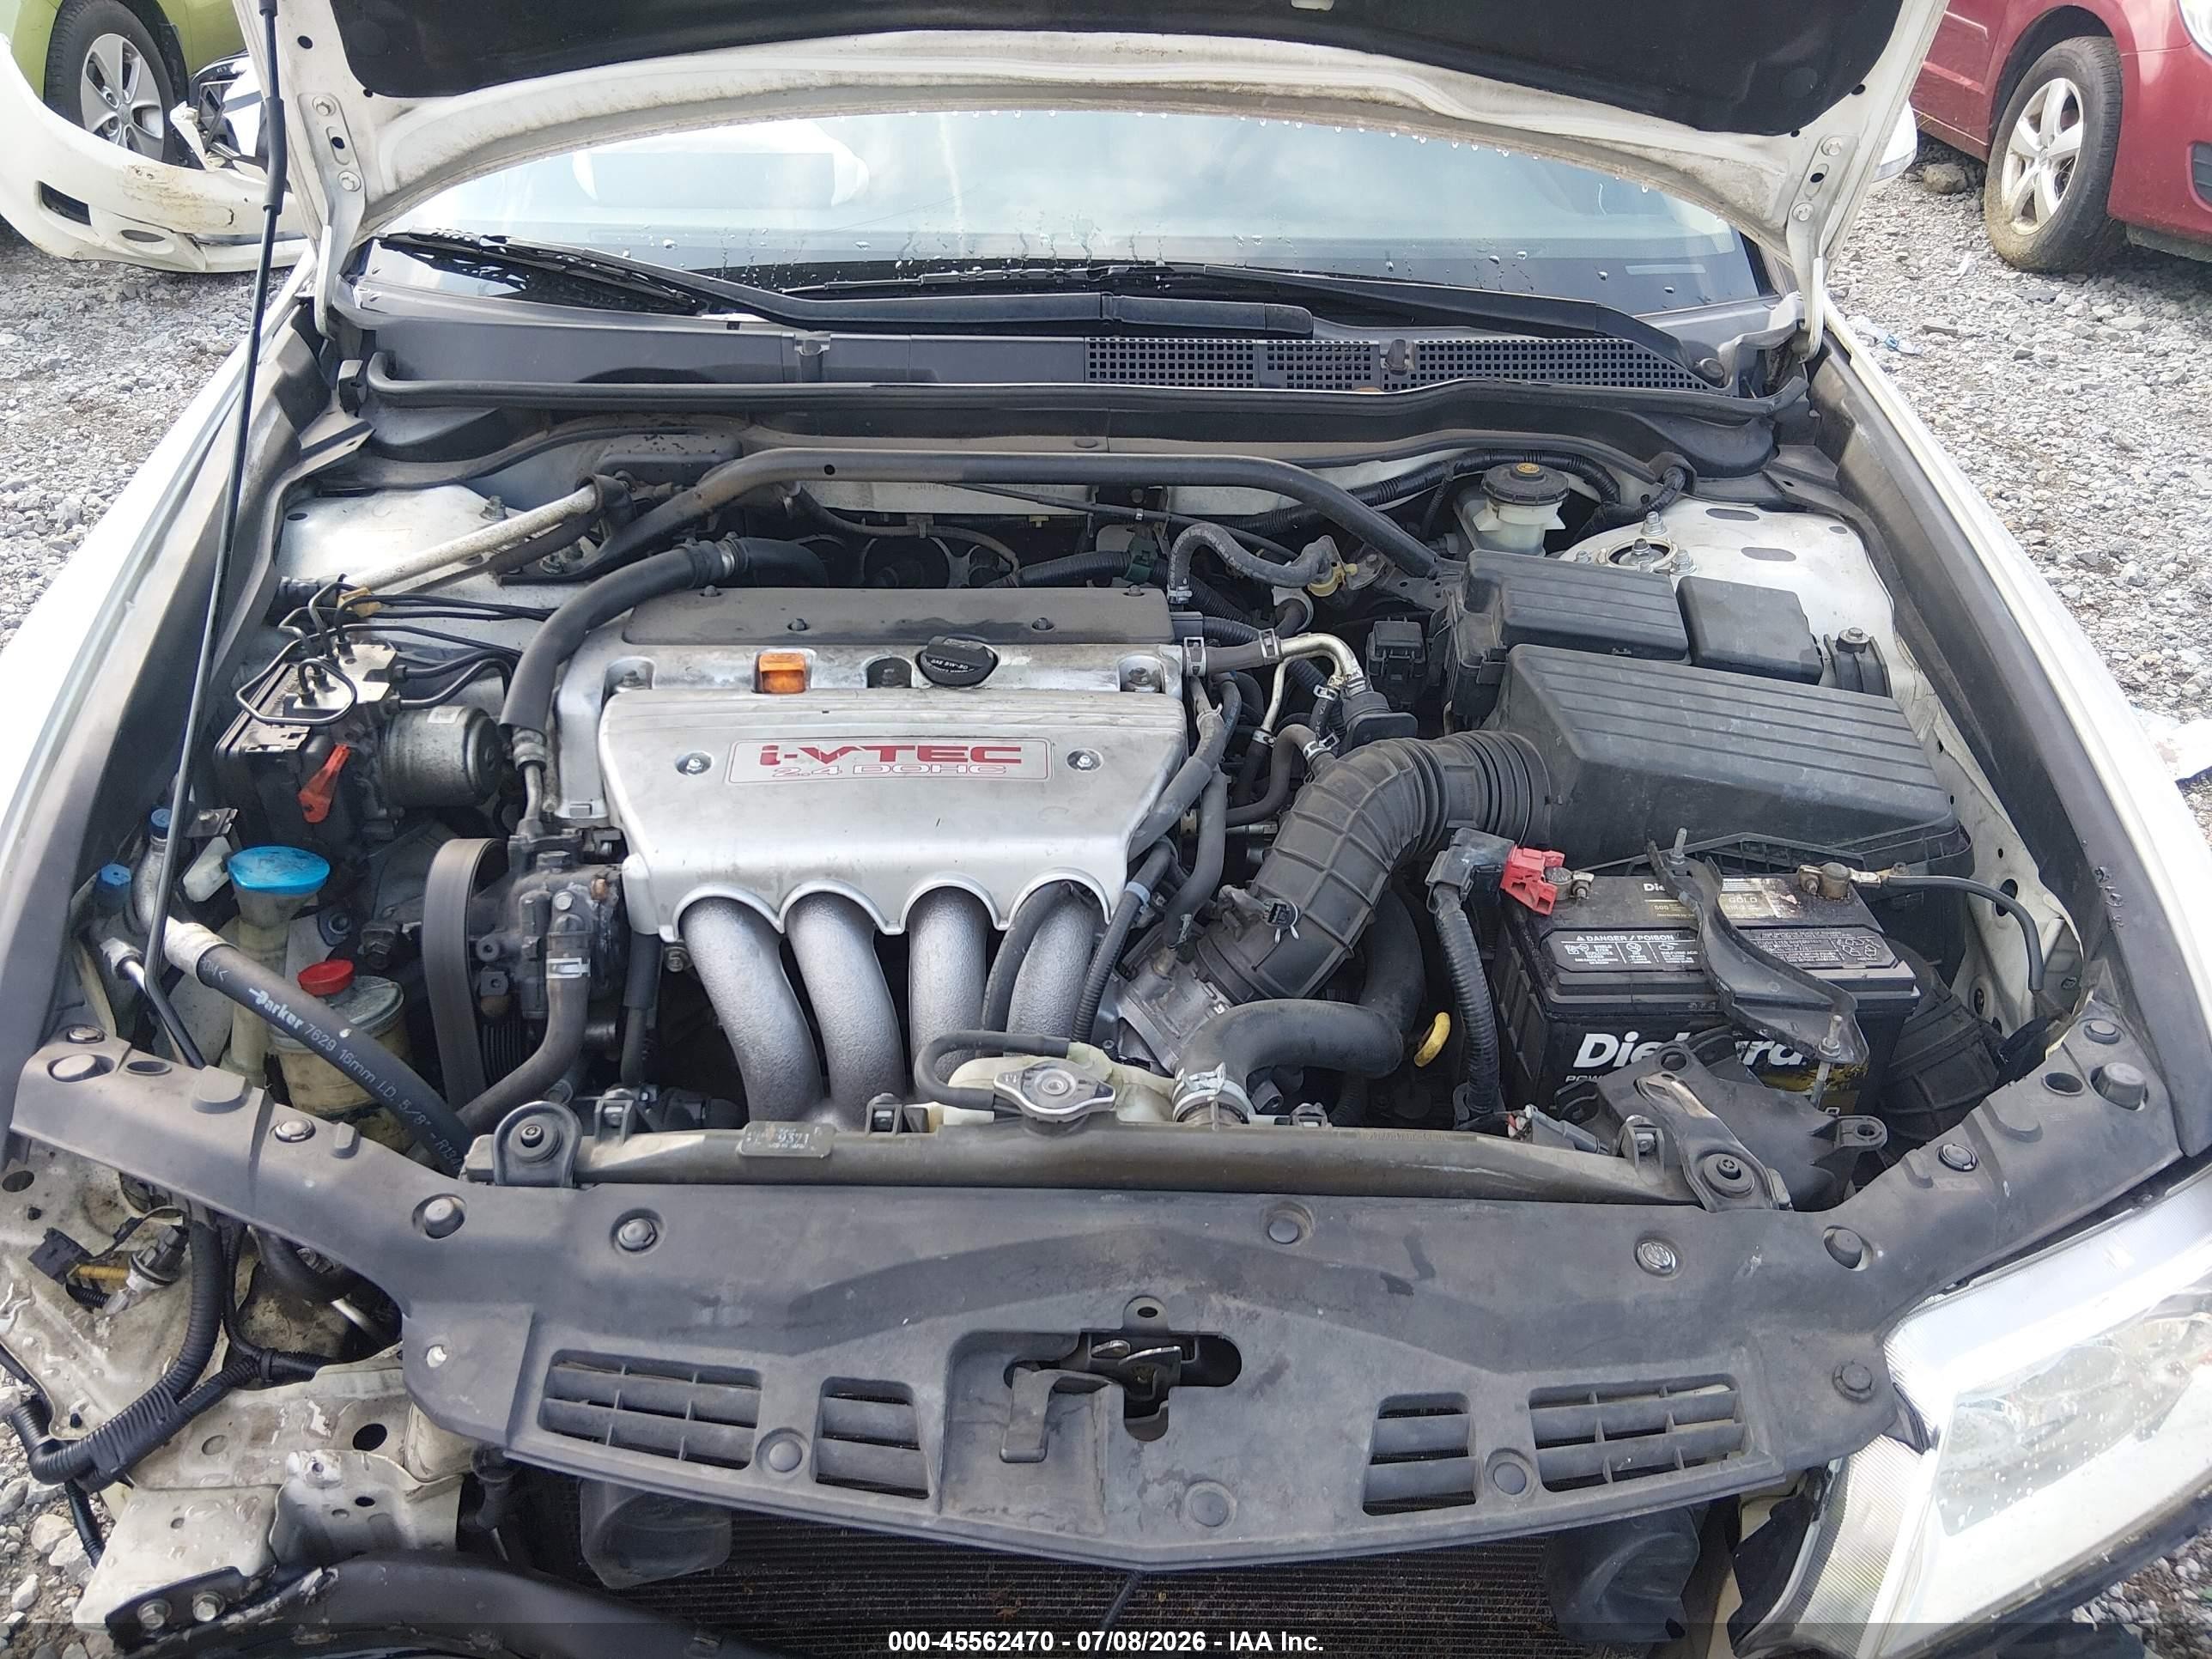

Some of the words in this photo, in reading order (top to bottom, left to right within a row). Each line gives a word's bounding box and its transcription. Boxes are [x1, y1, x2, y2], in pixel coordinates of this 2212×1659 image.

[760, 744, 1022, 766] i-VTEC
[773, 766, 842, 777] 2.4
[853, 763, 1006, 775] DOHC
[248, 988, 305, 1030] Parker
[304, 1023, 337, 1051] 7629
[337, 1048, 377, 1084] 16mm
